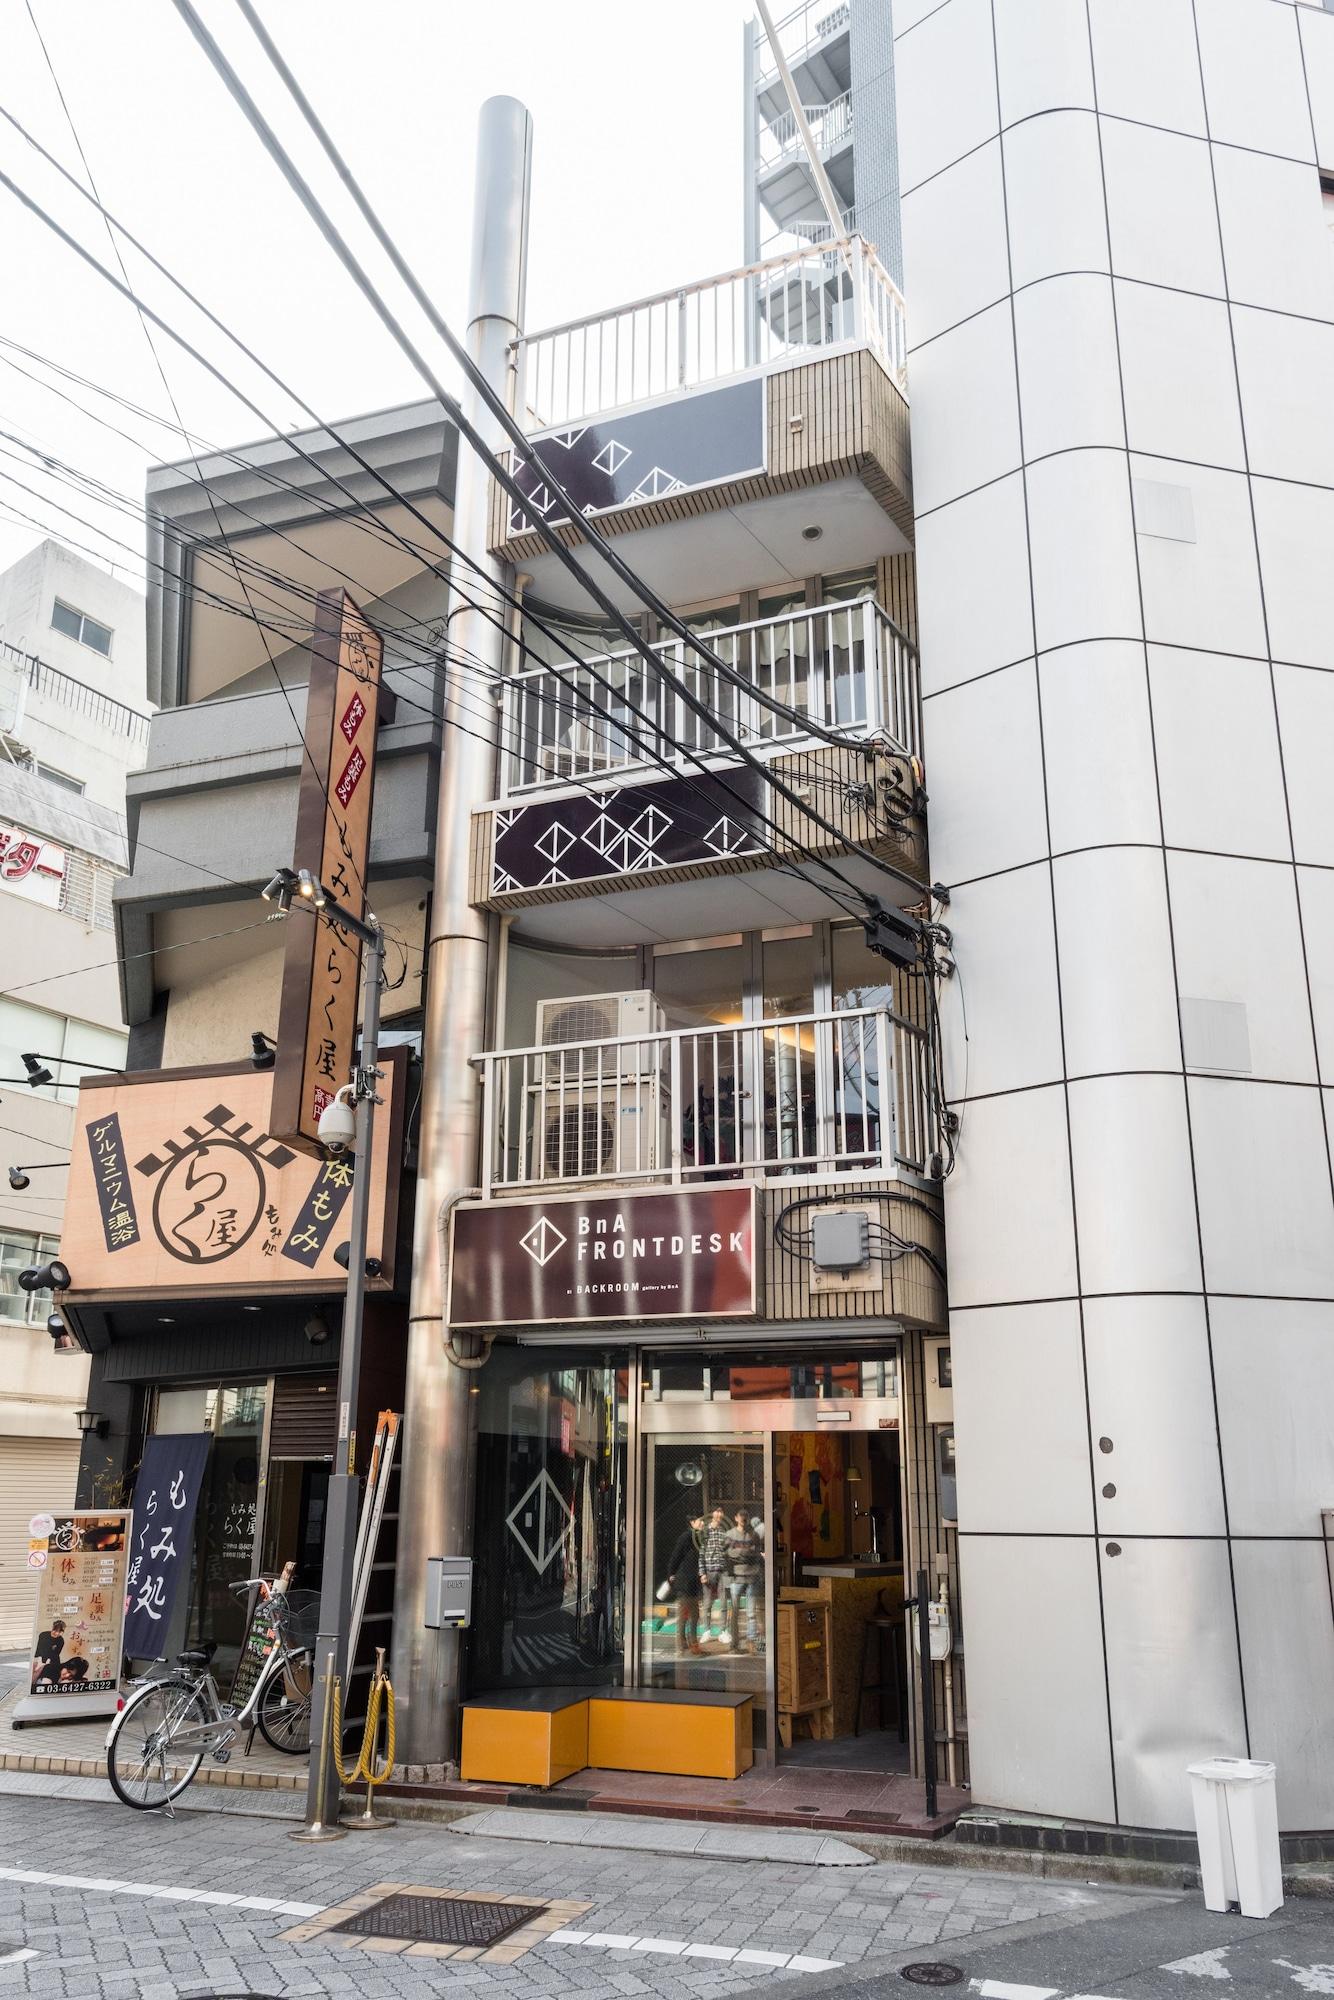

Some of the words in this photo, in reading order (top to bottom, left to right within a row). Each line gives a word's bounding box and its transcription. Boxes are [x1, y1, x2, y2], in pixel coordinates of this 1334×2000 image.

[0, 833, 63, 879] ター
[93, 1121, 136, 1246] ゲルマニウム温浴
[290, 1160, 354, 1253] 体もみ
[578, 1213, 626, 1235] BnA
[578, 1231, 744, 1262] FRONTDESK
[576, 1282, 640, 1295] BACKROOM
[128, 1490, 158, 1585] らく屋
[133, 1470, 187, 1620] もみ処
[46, 1680, 112, 1693] 03-6427-6322
